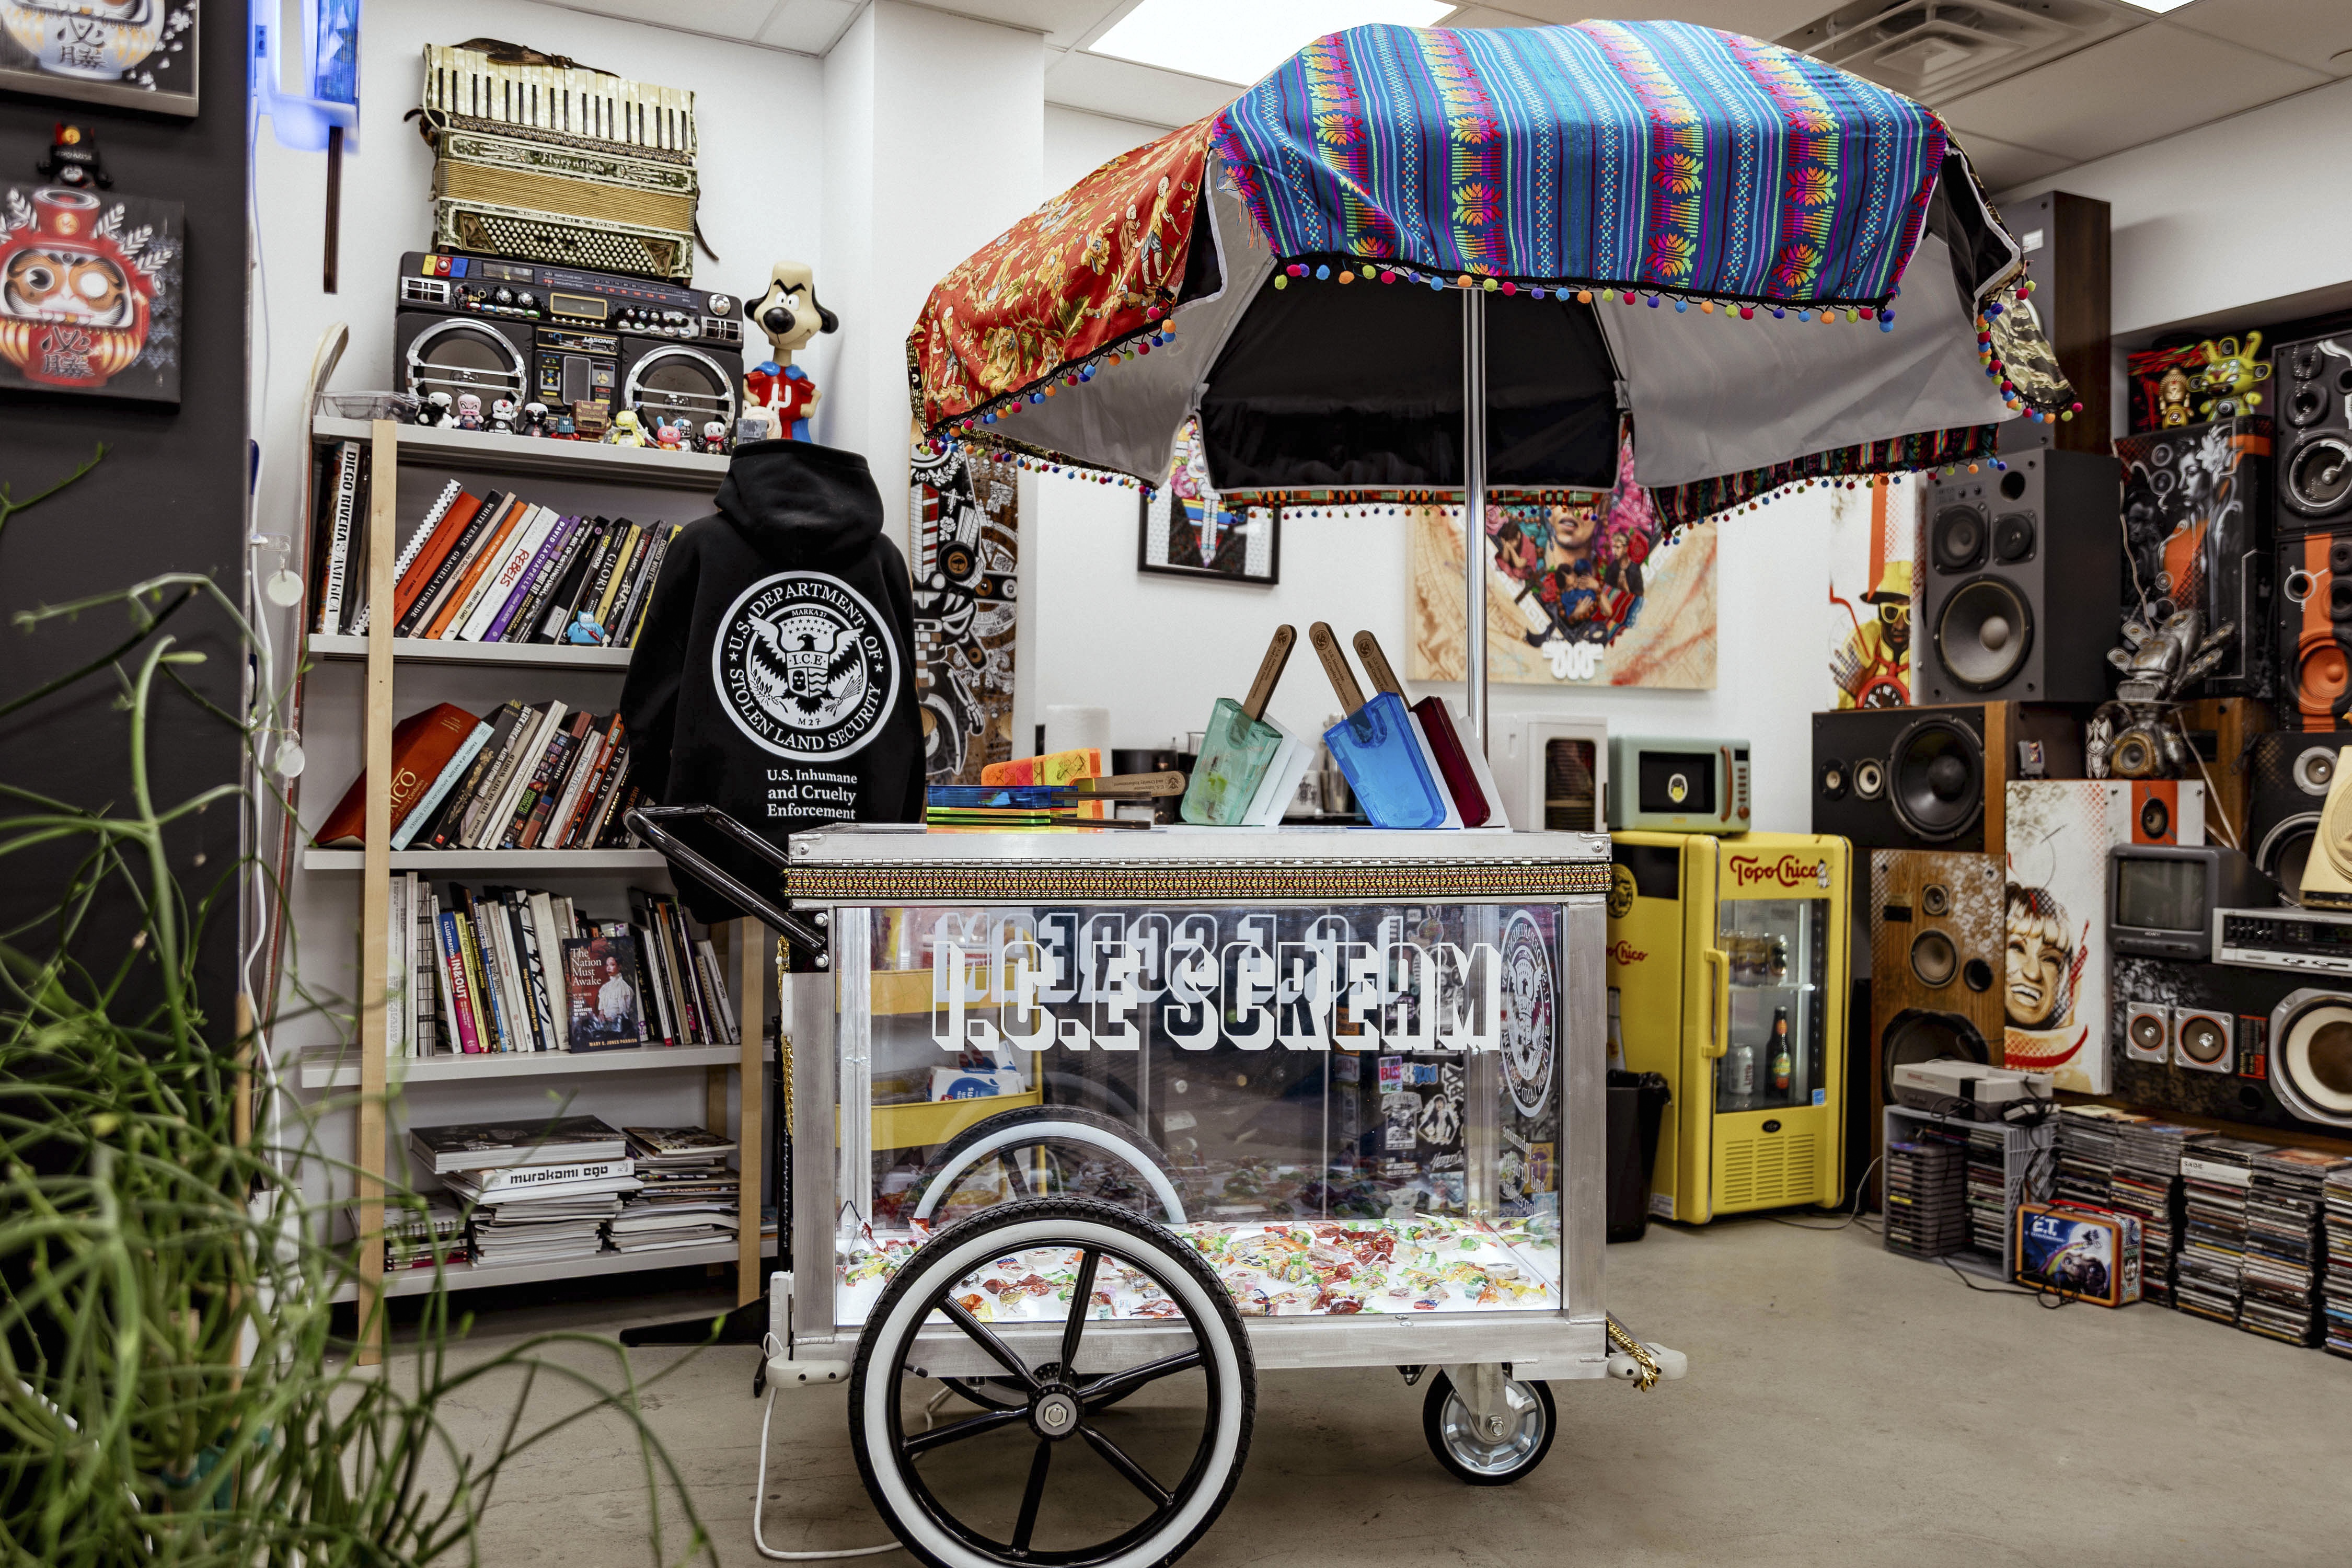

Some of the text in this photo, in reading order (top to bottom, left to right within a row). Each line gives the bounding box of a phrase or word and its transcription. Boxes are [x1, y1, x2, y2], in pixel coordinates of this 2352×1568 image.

[41, 326, 96, 379] 必勝
[583, 337, 616, 345] LASONIC
[771, 383, 792, 408] U
[342, 451, 356, 490] DIEGO
[475, 502, 494, 525] WHITE
[459, 524, 478, 548] FENCE
[548, 520, 566, 544] DAVID
[549, 524, 585, 581] THE ART OF GETTING
[591, 535, 613, 569] DEFINITION
[634, 538, 645, 558] URBAN
[639, 545, 647, 559] BEAT
[433, 550, 460, 585] GRACIELA
[451, 559, 468, 580] Gemeos
[499, 547, 531, 589] REBELS
[645, 538, 667, 582] DONDI WHITE
[329, 555, 344, 613] AMERICA
[529, 558, 556, 595] WHO SHOT YA?
[593, 552, 618, 594] GLORY
[410, 584, 436, 618] ITURBIDE
[791, 608, 819, 617] MARKA
[748, 582, 883, 660] DEPARTMENT OF
[1264, 654, 1274, 671] Cruelty
[1331, 658, 1346, 681] Inhumane
[1252, 671, 1266, 699] Enforcement
[1325, 661, 1338, 679] Cruelty
[1333, 677, 1353, 707] Enforcement
[1369, 668, 1382, 684] Cruelty
[503, 708, 519, 718] AZTECS
[729, 668, 882, 751] STOLEN LAND SECURITY
[508, 705, 533, 741] BLACK AFRICA
[464, 741, 478, 756] FABRIC
[447, 763, 462, 779] NATION
[552, 749, 572, 780] muralists
[578, 755, 588, 768] The
[597, 746, 625, 800] DREADS
[564, 768, 583, 796] AZTECS
[767, 769, 858, 784] U.S. Inhumane
[407, 779, 424, 800] Centuries
[431, 778, 449, 800] AMERICAN
[467, 753, 516, 839] Bernal THE OLMEC WORLD
[517, 789, 532, 812] WORLD
[768, 785, 857, 805] and Cruelty
[523, 792, 536, 814] GRAFFITI
[767, 804, 856, 820] Enforcement
[408, 811, 424, 829] STORIES
[1730, 854, 1818, 887] Topo Chico
[443, 920, 456, 959] ILLUSTRATORS
[570, 948, 589, 958] The
[572, 958, 602, 966] Nation
[1615, 940, 1648, 965] Chico
[450, 958, 467, 1000] IN&OUT
[572, 967, 595, 976] Must
[572, 977, 602, 986] Awake
[527, 996, 537, 1019] Magdalena
[933, 941, 1501, 1051] I.C.E SCREAM
[510, 1165, 609, 1184] murakami ego
[2183, 1160, 2204, 1169] SADE
[2032, 1215, 2060, 1236] E.T.
